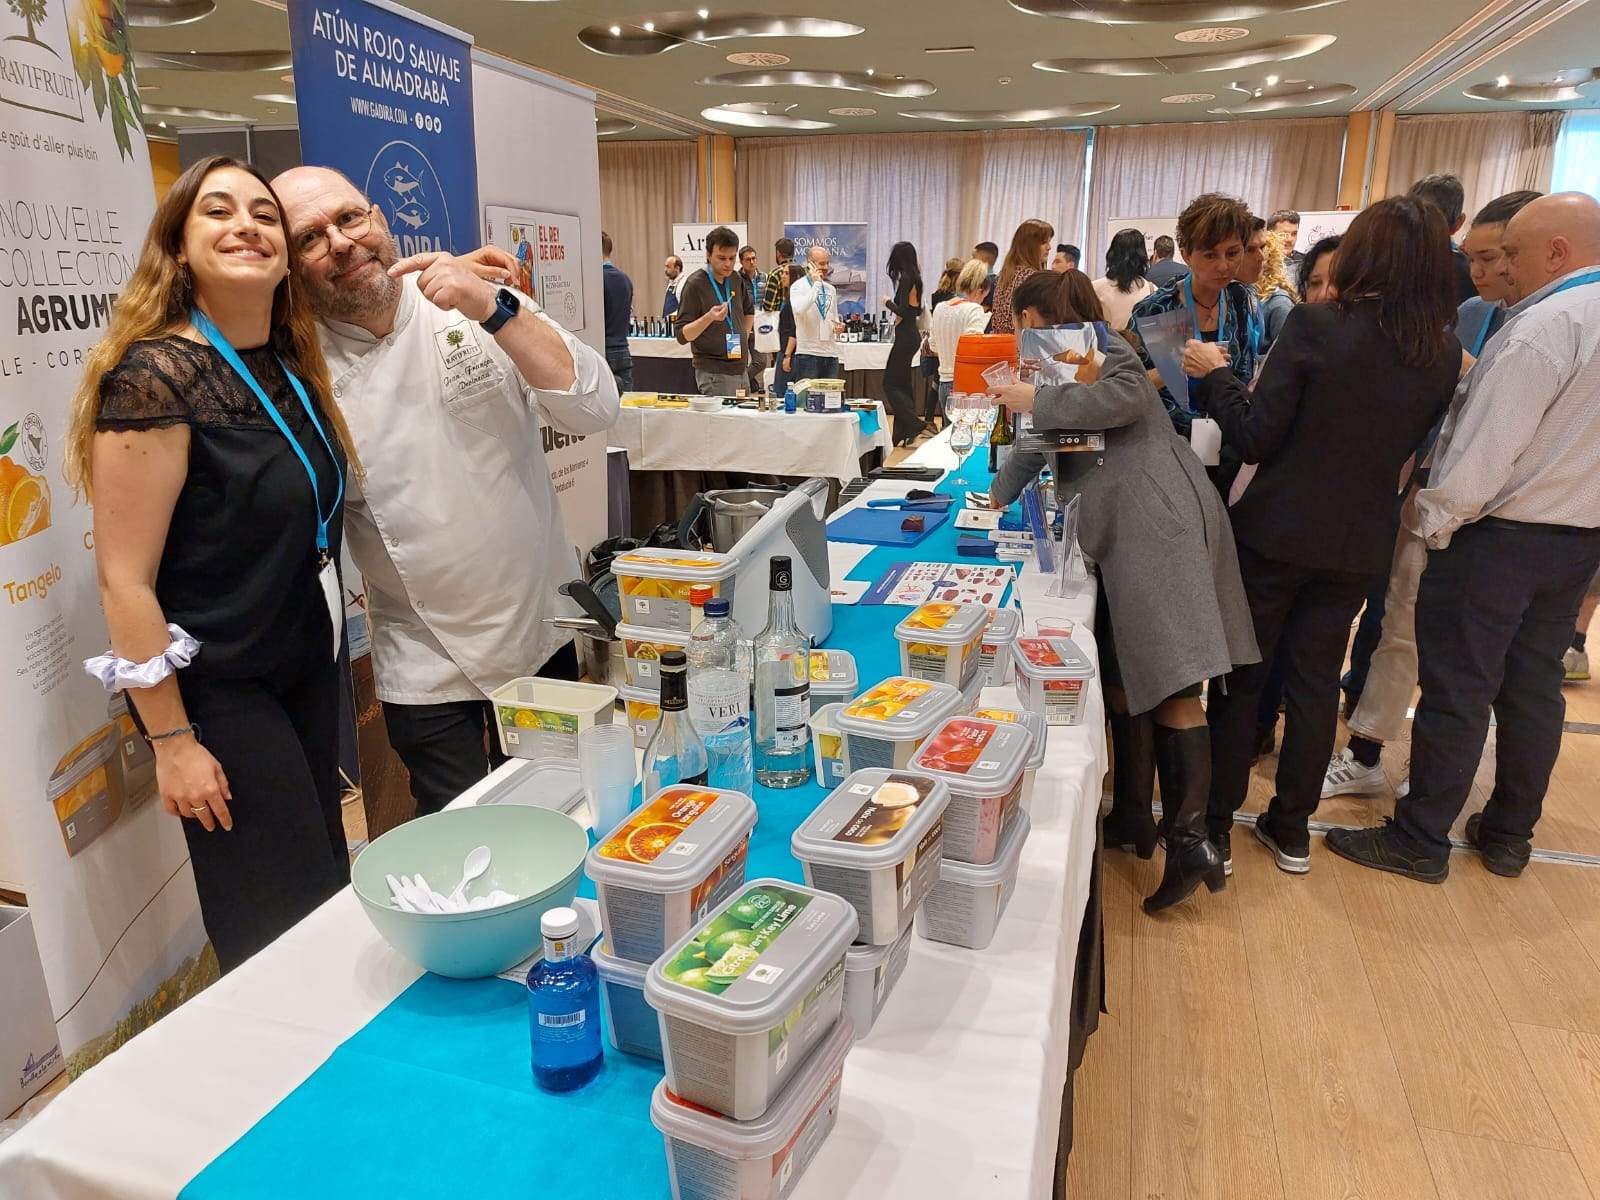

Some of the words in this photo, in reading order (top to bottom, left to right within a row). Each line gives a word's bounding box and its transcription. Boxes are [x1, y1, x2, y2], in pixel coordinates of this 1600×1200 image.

[313, 8, 359, 49] ATÚN
[364, 26, 404, 63] ROJO
[410, 44, 460, 82] SALVAJE
[335, 50, 357, 81] DE
[363, 60, 449, 107] ALMADRABA
[351, 97, 409, 125] WWW.GADIRA.COM
[9, 131, 31, 149] goût
[33, 134, 65, 153] d'aller
[67, 140, 84, 160] plus
[84, 143, 98, 160] loin
[0, 200, 122, 244] NOUVELLE
[539, 225, 548, 242] EL
[549, 226, 560, 242] REY
[395, 234, 442, 258] ADIRA
[540, 245, 549, 260] DE
[550, 245, 565, 260] OROS
[794, 237, 837, 247] SOMMOS
[794, 247, 847, 256] MOAÑA
[0, 248, 137, 287] COLLECTION
[446, 345, 479, 365] RAVIFRUIT
[3, 562, 61, 605] Tangelo
[709, 702, 741, 718] VERI
[748, 932, 766, 950] vert
[759, 918, 780, 939] Key
[772, 900, 796, 925] Lime
